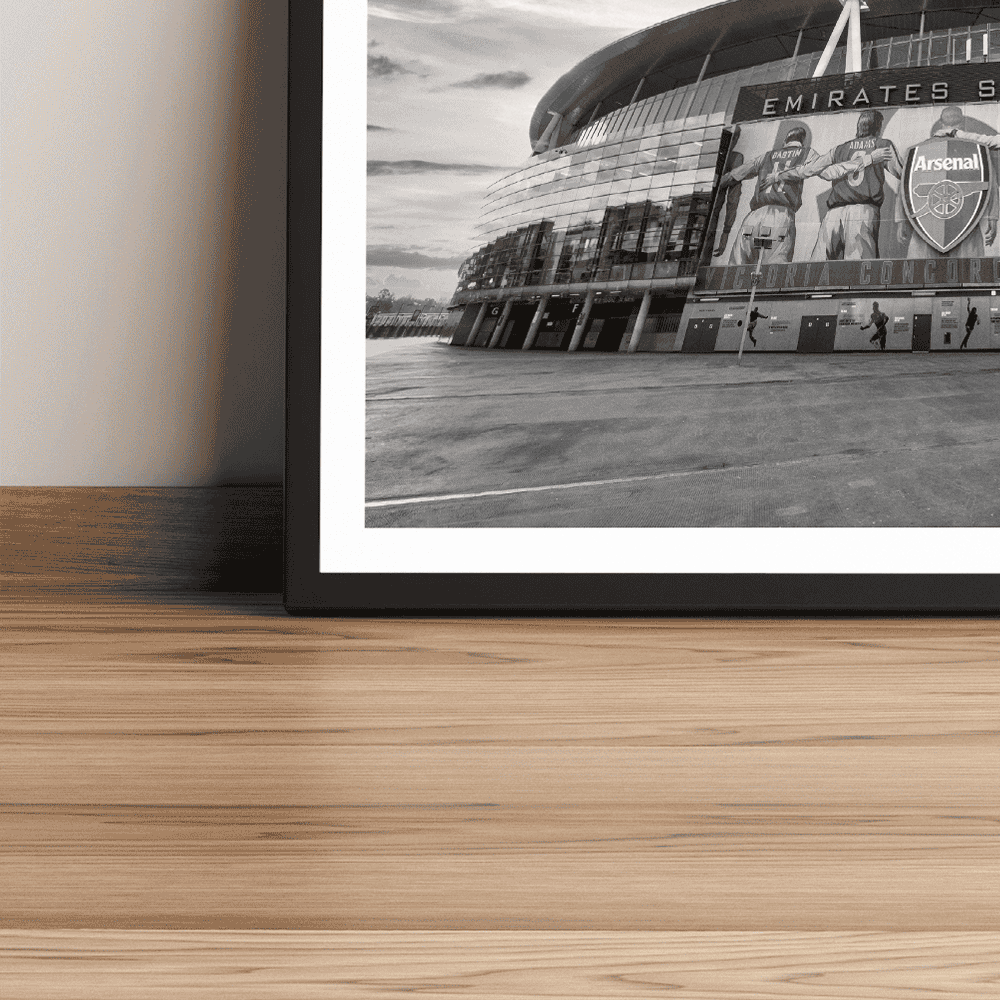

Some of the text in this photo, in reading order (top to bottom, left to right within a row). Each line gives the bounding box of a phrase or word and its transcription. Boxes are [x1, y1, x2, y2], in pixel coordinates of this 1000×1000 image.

[762, 82, 948, 116] EMIRATES
[914, 153, 980, 171] Arsenal
[705, 263, 830, 290] VICORIA
